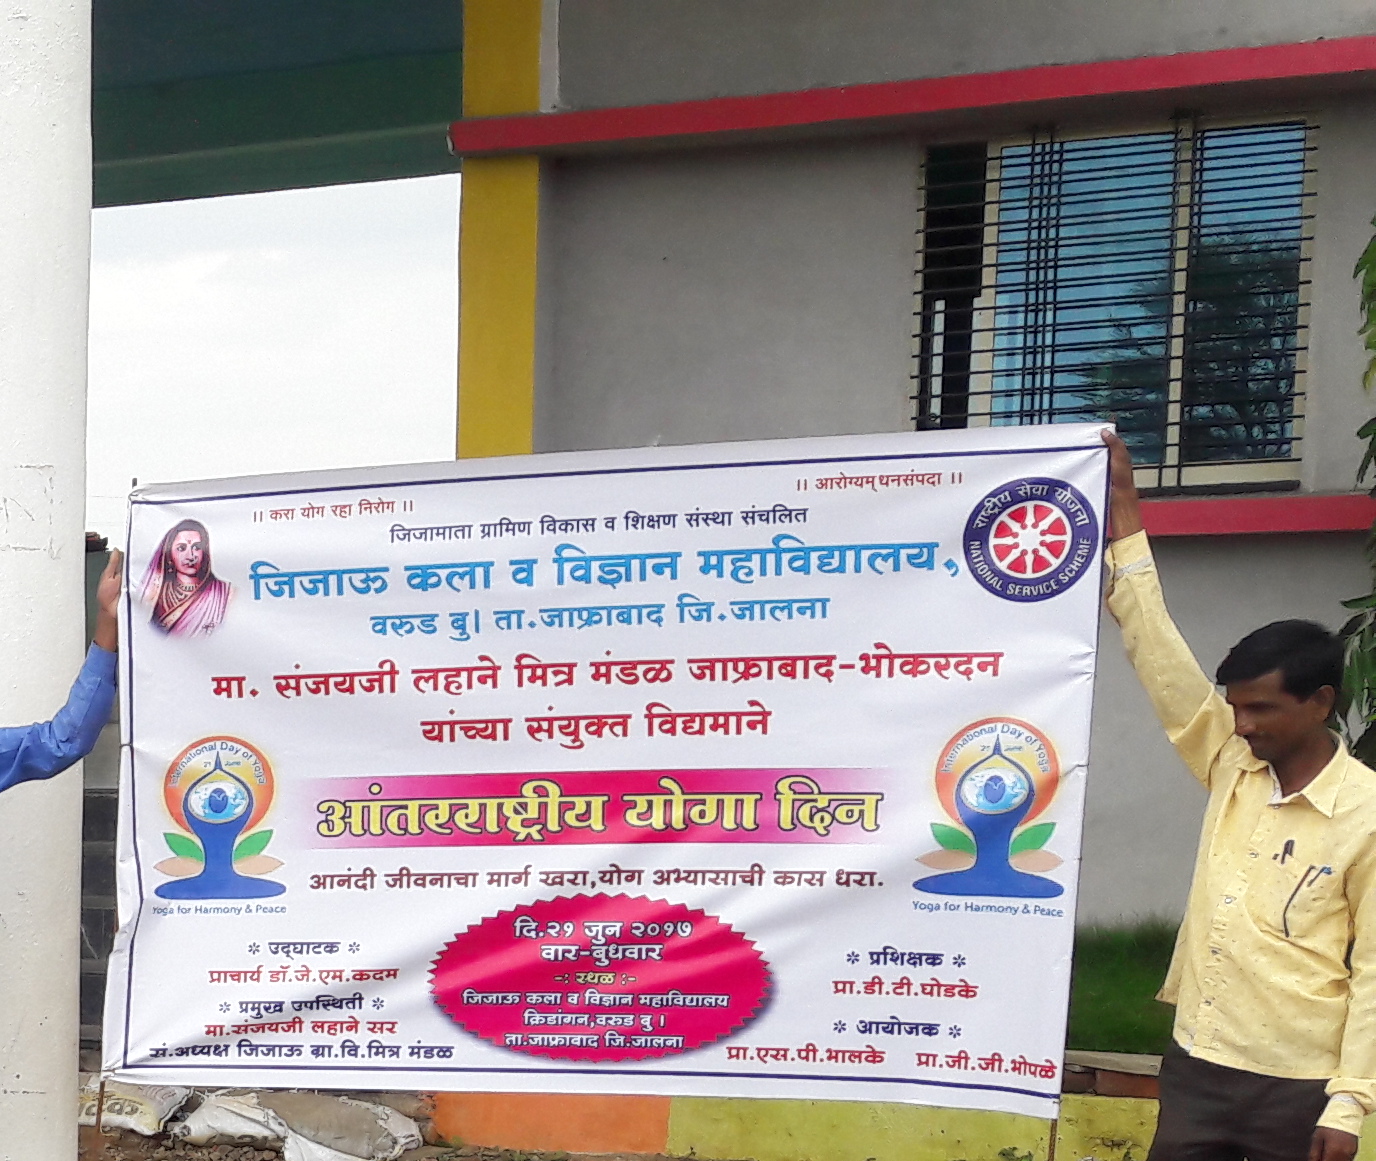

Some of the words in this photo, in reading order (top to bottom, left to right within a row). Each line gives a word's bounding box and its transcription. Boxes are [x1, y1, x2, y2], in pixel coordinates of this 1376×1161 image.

[269, 508, 295, 522] करा
[300, 503, 325, 518] योग
[331, 504, 351, 518] रहा
[358, 497, 396, 515] निरोग
[973, 490, 1012, 529] राष्ट्रीय
[1015, 481, 1049, 498] सेवा
[1054, 486, 1091, 527] योजना
[389, 524, 473, 544] जिजामाता
[480, 519, 532, 539] ग्रामिण
[539, 514, 596, 536] विकास
[604, 517, 617, 531] व
[624, 509, 678, 531] शिक्षण
[685, 505, 732, 527] संस्था
[741, 503, 809, 525] संचलित
[249, 560, 389, 600] जिजाऊ
[404, 560, 495, 593] कला
[509, 557, 538, 587] व
[553, 543, 682, 589] विज्ञान
[697, 533, 960, 585] महाविद्यालय,
[969, 540, 1004, 591] NATIONAL
[1006, 578, 1060, 597] SERVICE
[1058, 536, 1092, 584] SCHEME
[370, 613, 439, 638] वरुड
[493, 603, 666, 632] ता.जाफ्राबाद
[676, 592, 831, 625] जि.जालना
[211, 676, 260, 699] मा.
[273, 659, 399, 699] संजयजी
[411, 654, 502, 695] लहाने
[513, 654, 578, 688] मित्र
[590, 650, 675, 686] मंडळ
[687, 642, 1005, 685] जाफ्राबाद-भोकरदन
[420, 708, 513, 743] यांच्या
[525, 704, 633, 750] संयुक्त
[644, 700, 773, 738] विद्यमाने
[219, 741, 240, 756] Day
[241, 750, 253, 761] of
[940, 724, 998, 773] International
[1000, 724, 1024, 740] Day
[1025, 734, 1039, 746] of
[317, 779, 610, 842] आंतरराष्ट्रीय
[622, 776, 763, 832] योगा
[774, 775, 885, 837] दिन
[309, 867, 377, 891] आनंदी
[385, 866, 479, 889] जीवनाचा
[486, 864, 532, 888] मार्ग
[652, 862, 766, 887] अभ्यासाची
[773, 869, 827, 887] कास
[836, 869, 884, 887] धरा.
[152, 905, 174, 916] Yoga
[177, 904, 192, 914] for
[194, 905, 242, 917] Harmony
[245, 904, 253, 914] &
[256, 904, 287, 914] Peace
[912, 901, 941, 912] Yoga
[944, 901, 960, 911] for
[964, 902, 1019, 915] Harmony
[1022, 903, 1031, 914] &
[1033, 905, 1064, 917] Peace
[514, 916, 576, 938] दि.२१
[584, 921, 624, 945] जुन
[630, 920, 693, 938] २०१७
[541, 943, 664, 966] वार-बुधवार
[869, 946, 944, 967] प्रशिक्षक
[208, 965, 264, 984] प्राचार्य
[238, 1000, 285, 1019] प्रमुख
[291, 992, 364, 1012] उपस्थिती
[462, 989, 521, 1006] जिजाऊ
[526, 992, 563, 1006] कला
[567, 992, 579, 1005] व
[584, 988, 633, 1007] विज्ञान
[639, 990, 730, 1008] महाविद्यालय
[311, 1015, 360, 1036] लहाने
[367, 1021, 398, 1035] सर
[856, 1016, 941, 1037] आयोजक
[237, 1039, 304, 1058] जिजाऊ
[409, 1040, 455, 1059] मंडळ
[604, 1031, 685, 1048] जि.जालना
